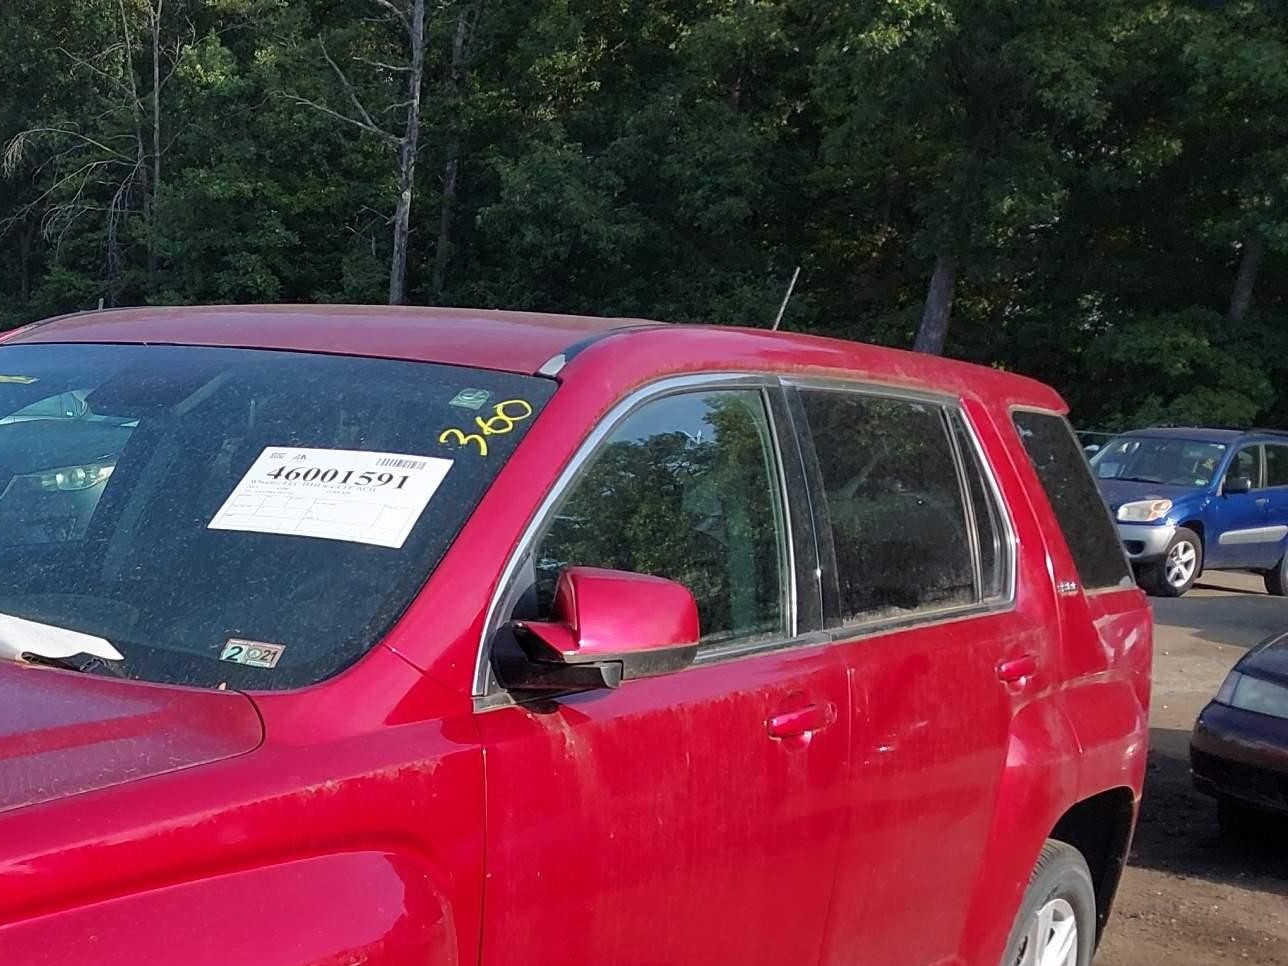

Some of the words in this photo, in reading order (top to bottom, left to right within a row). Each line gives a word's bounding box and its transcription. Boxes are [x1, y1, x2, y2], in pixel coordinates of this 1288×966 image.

[439, 399, 532, 456] 360
[267, 465, 411, 490] 46001591
[226, 646, 243, 662] 2
[260, 649, 279, 662] 21
